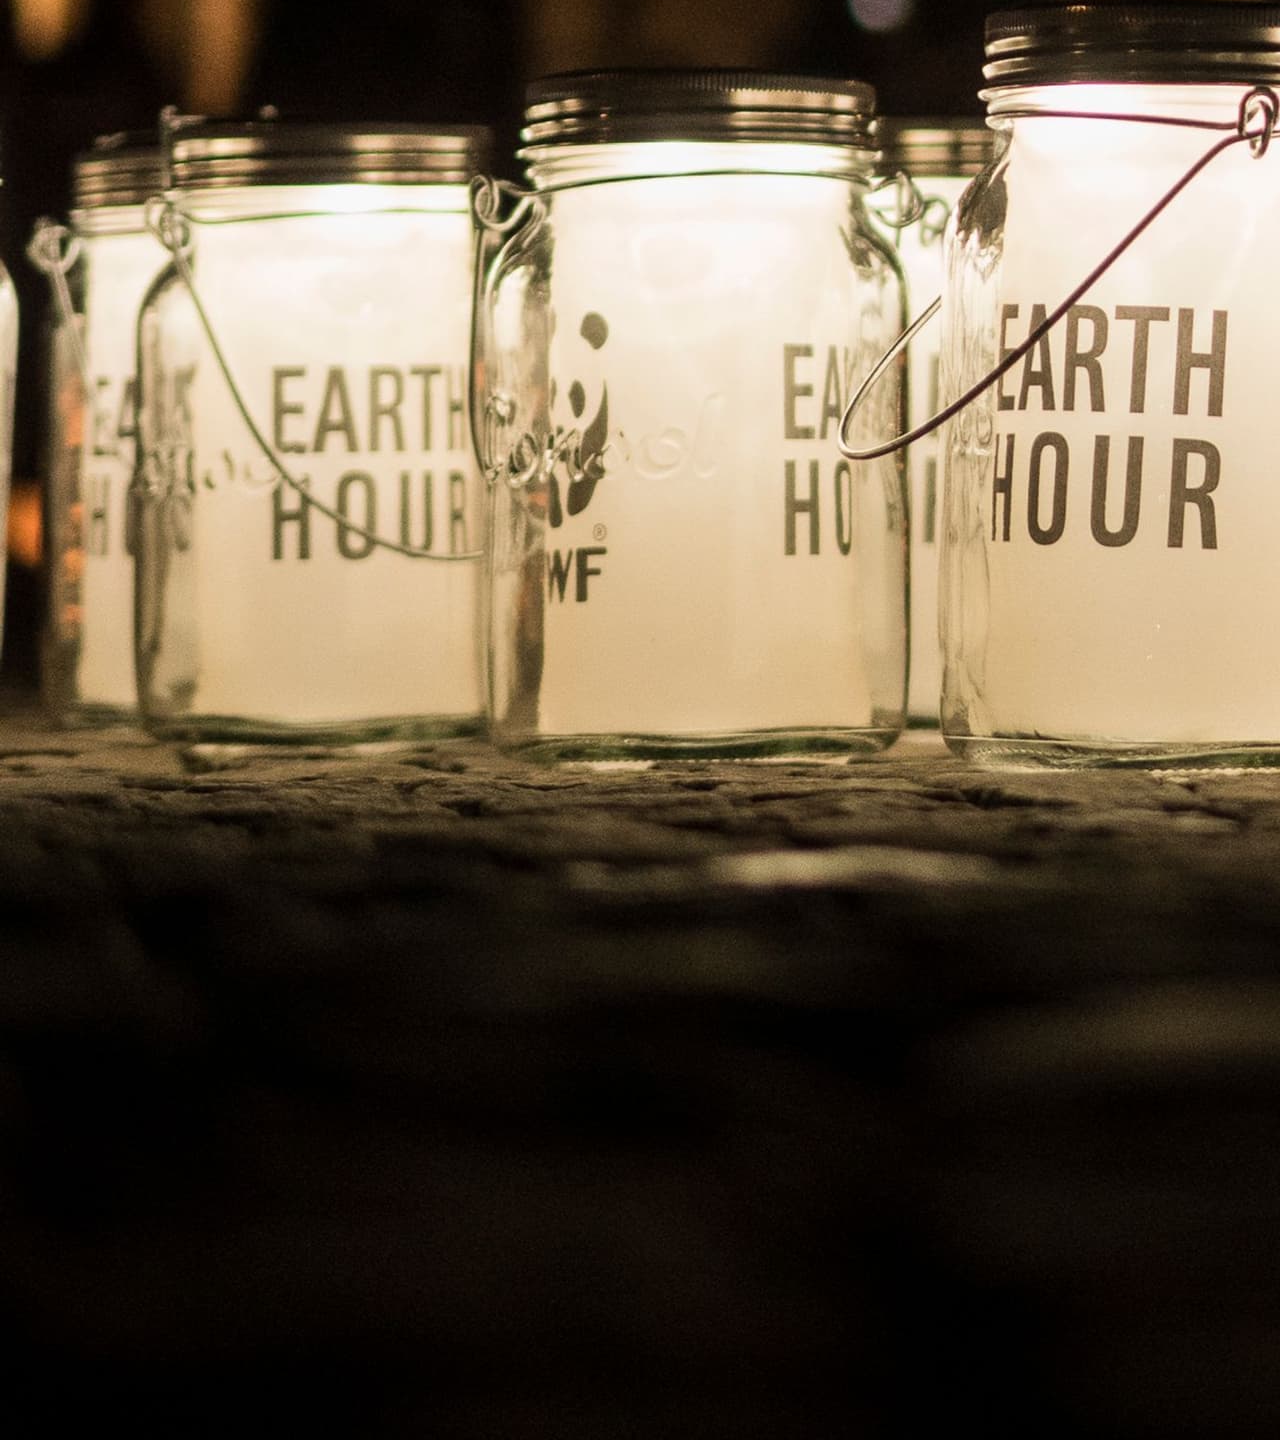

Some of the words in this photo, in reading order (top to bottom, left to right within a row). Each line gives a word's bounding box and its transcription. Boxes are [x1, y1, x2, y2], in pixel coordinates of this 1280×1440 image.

[271, 364, 467, 453] EARTH
[997, 303, 1228, 417] EARTH
[271, 471, 468, 560] HOUR
[991, 431, 1222, 550] HOUR
